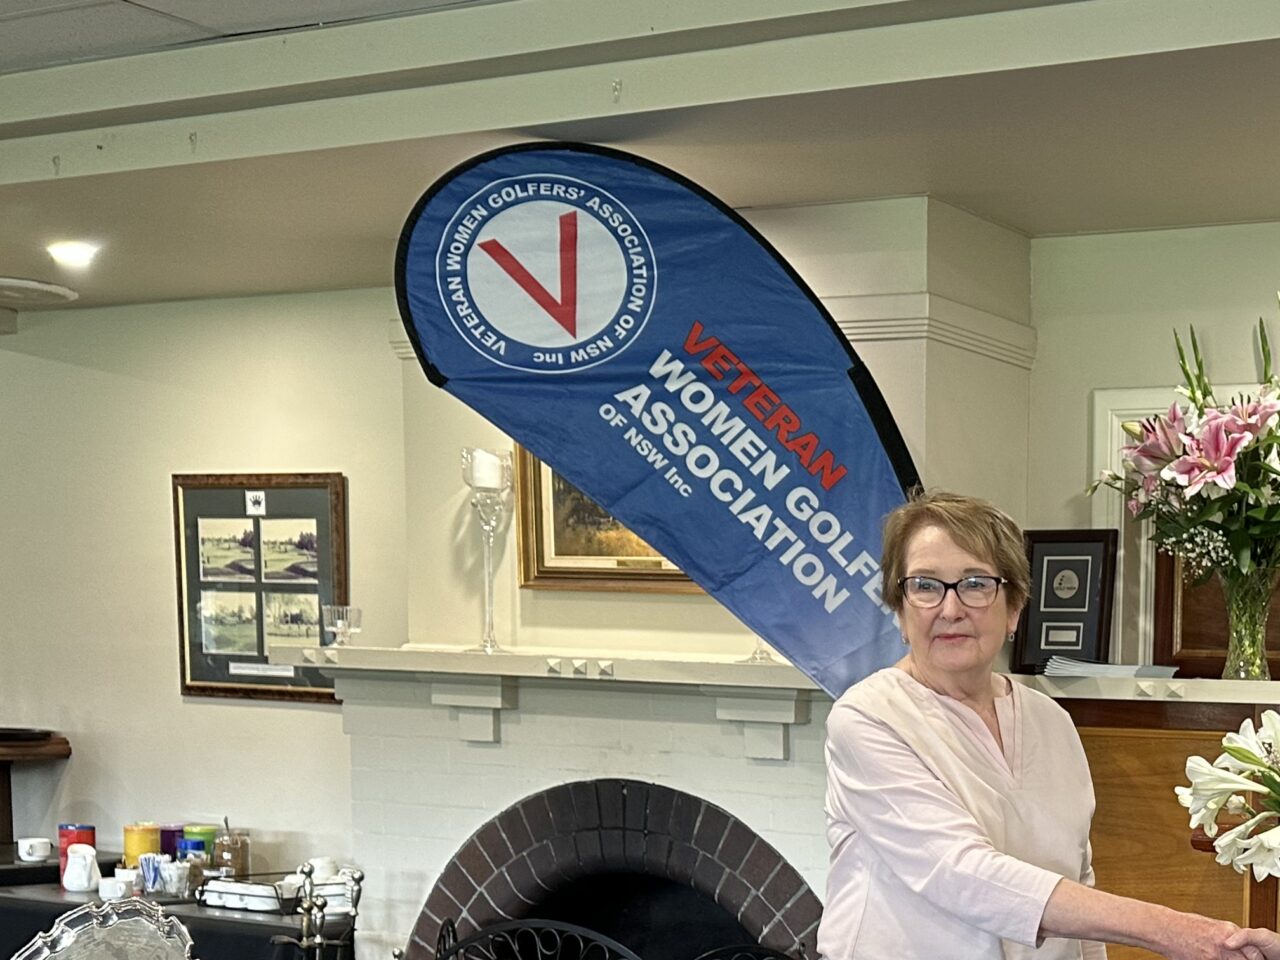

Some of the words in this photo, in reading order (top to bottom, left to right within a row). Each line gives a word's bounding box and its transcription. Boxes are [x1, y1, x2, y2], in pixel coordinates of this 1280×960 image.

[447, 205, 488, 270] WOMEN
[477, 210, 577, 339] V
[586, 197, 648, 312] ASSOCIATION
[447, 277, 506, 355] VETERAN
[533, 352, 563, 365] Inc
[571, 335, 615, 364] NSW
[615, 314, 635, 341] OF
[599, 403, 628, 430] OF
[623, 426, 669, 470] NSW
[664, 466, 693, 498] Inc
[683, 320, 848, 492] VETERAN
[614, 383, 850, 614] ASSOCIATION
[649, 349, 791, 491] WOMEN
[785, 486, 897, 618] GOLFE
